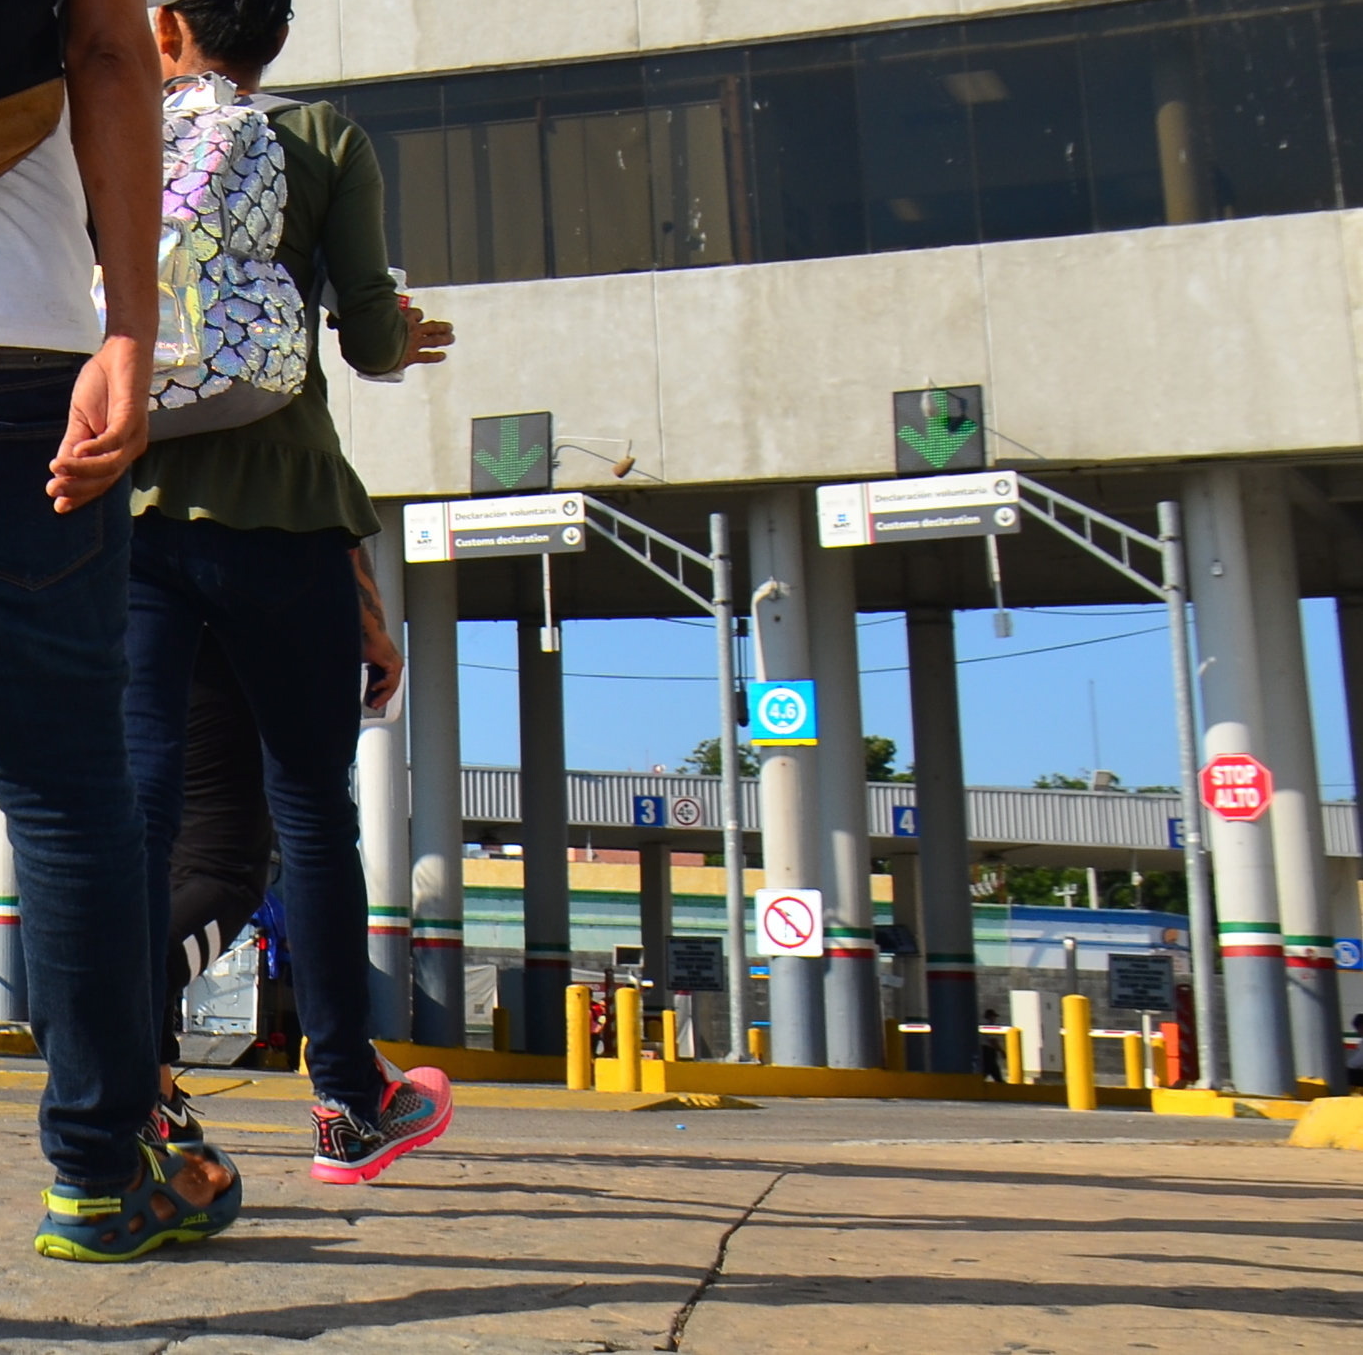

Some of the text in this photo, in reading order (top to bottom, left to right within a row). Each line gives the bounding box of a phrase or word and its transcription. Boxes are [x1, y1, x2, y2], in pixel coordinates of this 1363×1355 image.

[496, 532, 550, 545] declaration
[768, 702, 797, 720] 4.6
[1210, 764, 1258, 786] STOP
[1214, 787, 1261, 809] ALTO
[640, 798, 656, 825] 3
[899, 809, 915, 834] 4
